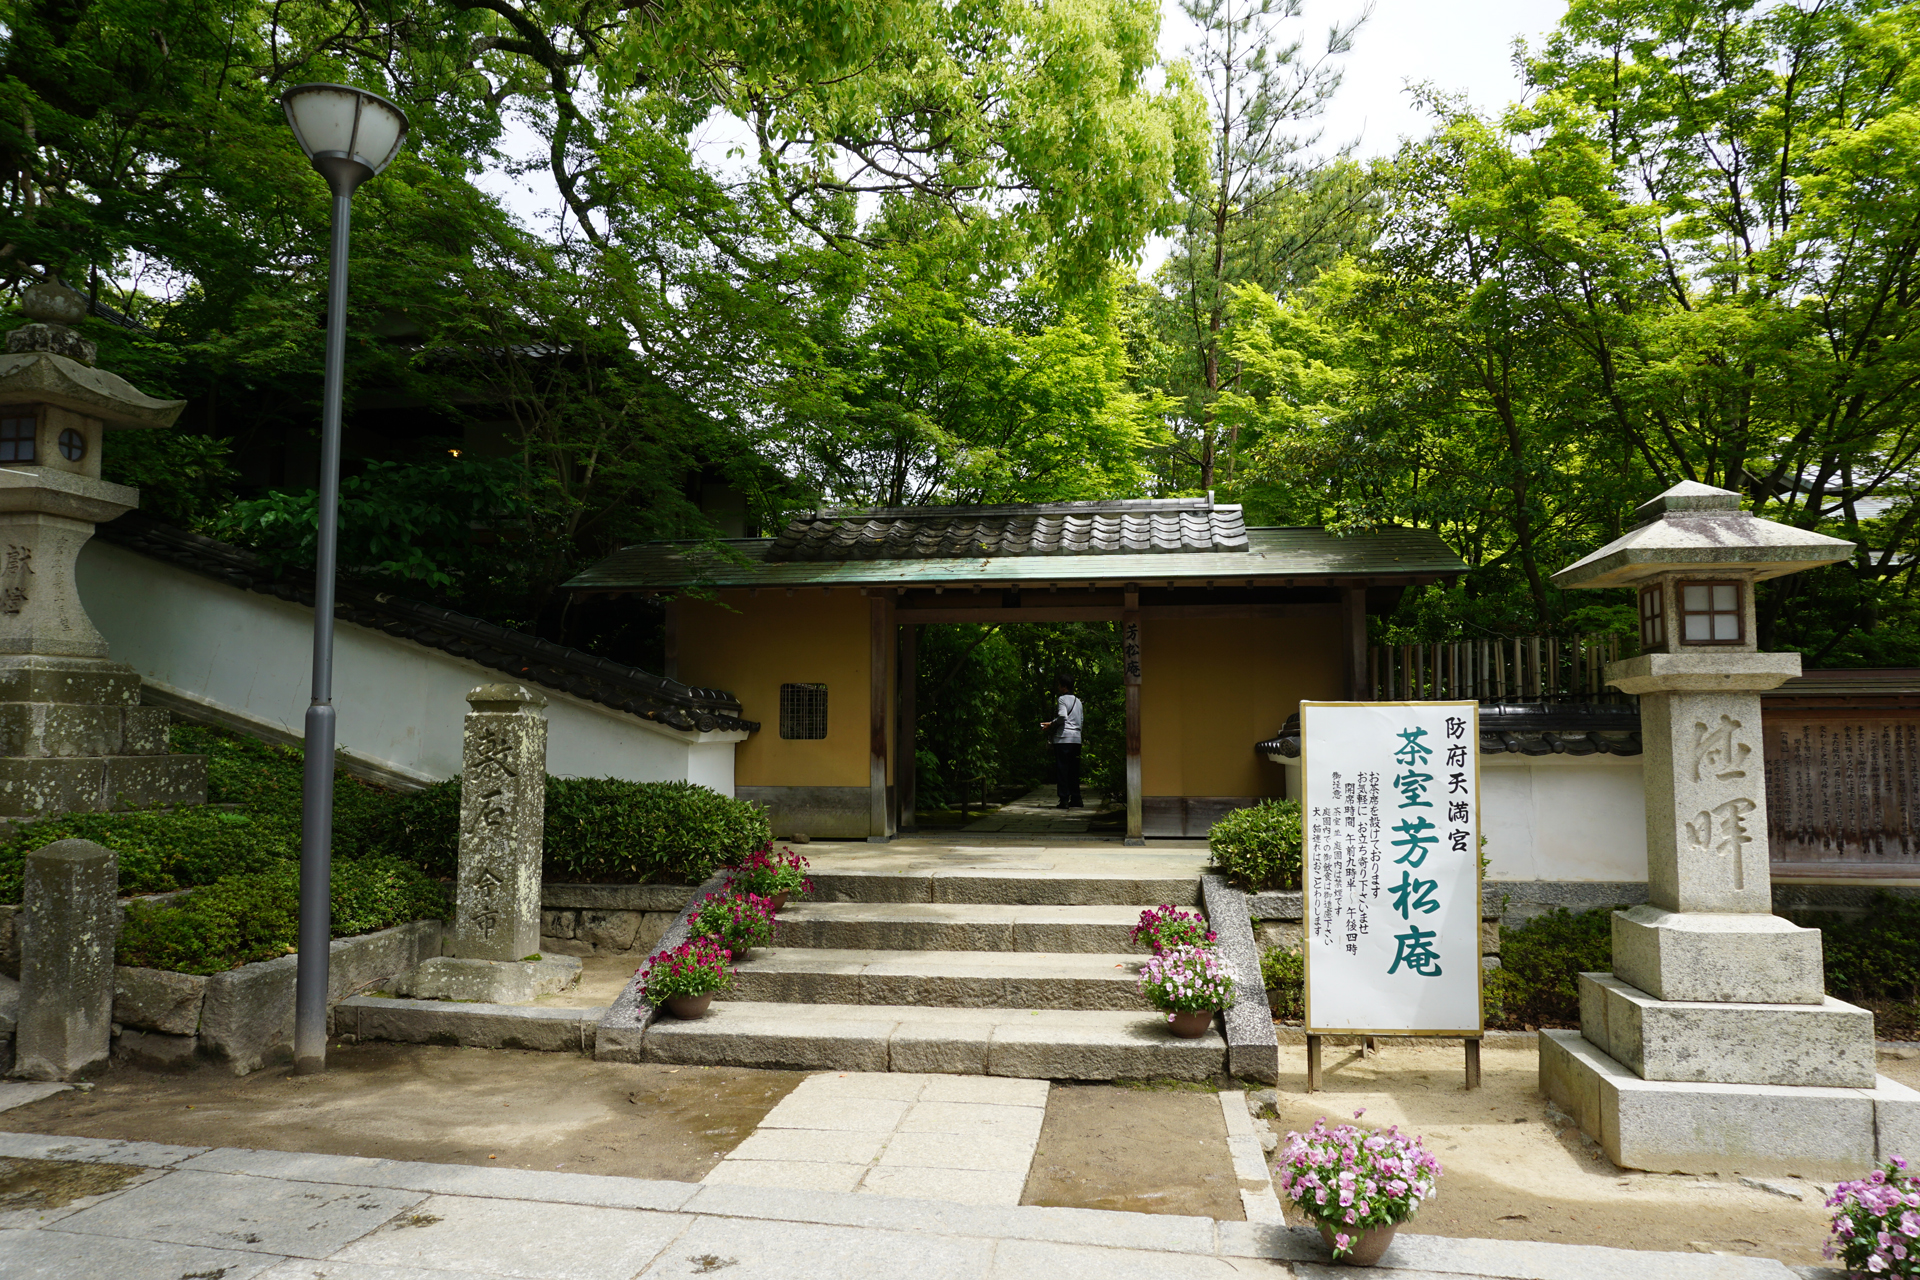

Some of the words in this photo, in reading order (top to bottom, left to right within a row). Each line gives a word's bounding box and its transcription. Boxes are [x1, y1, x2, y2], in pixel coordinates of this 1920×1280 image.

[1125, 622, 1141, 678] 芳松庵
[1343, 782, 1356, 828] 開席時間
[1356, 771, 1368, 816] お気軽に
[1368, 771, 1382, 899] お茶席を設けております
[1444, 716, 1470, 852] 防府天満宮
[1357, 821, 1369, 934] お立ち寄り下さいませ
[1387, 726, 1443, 977] 茶室芳松庵
